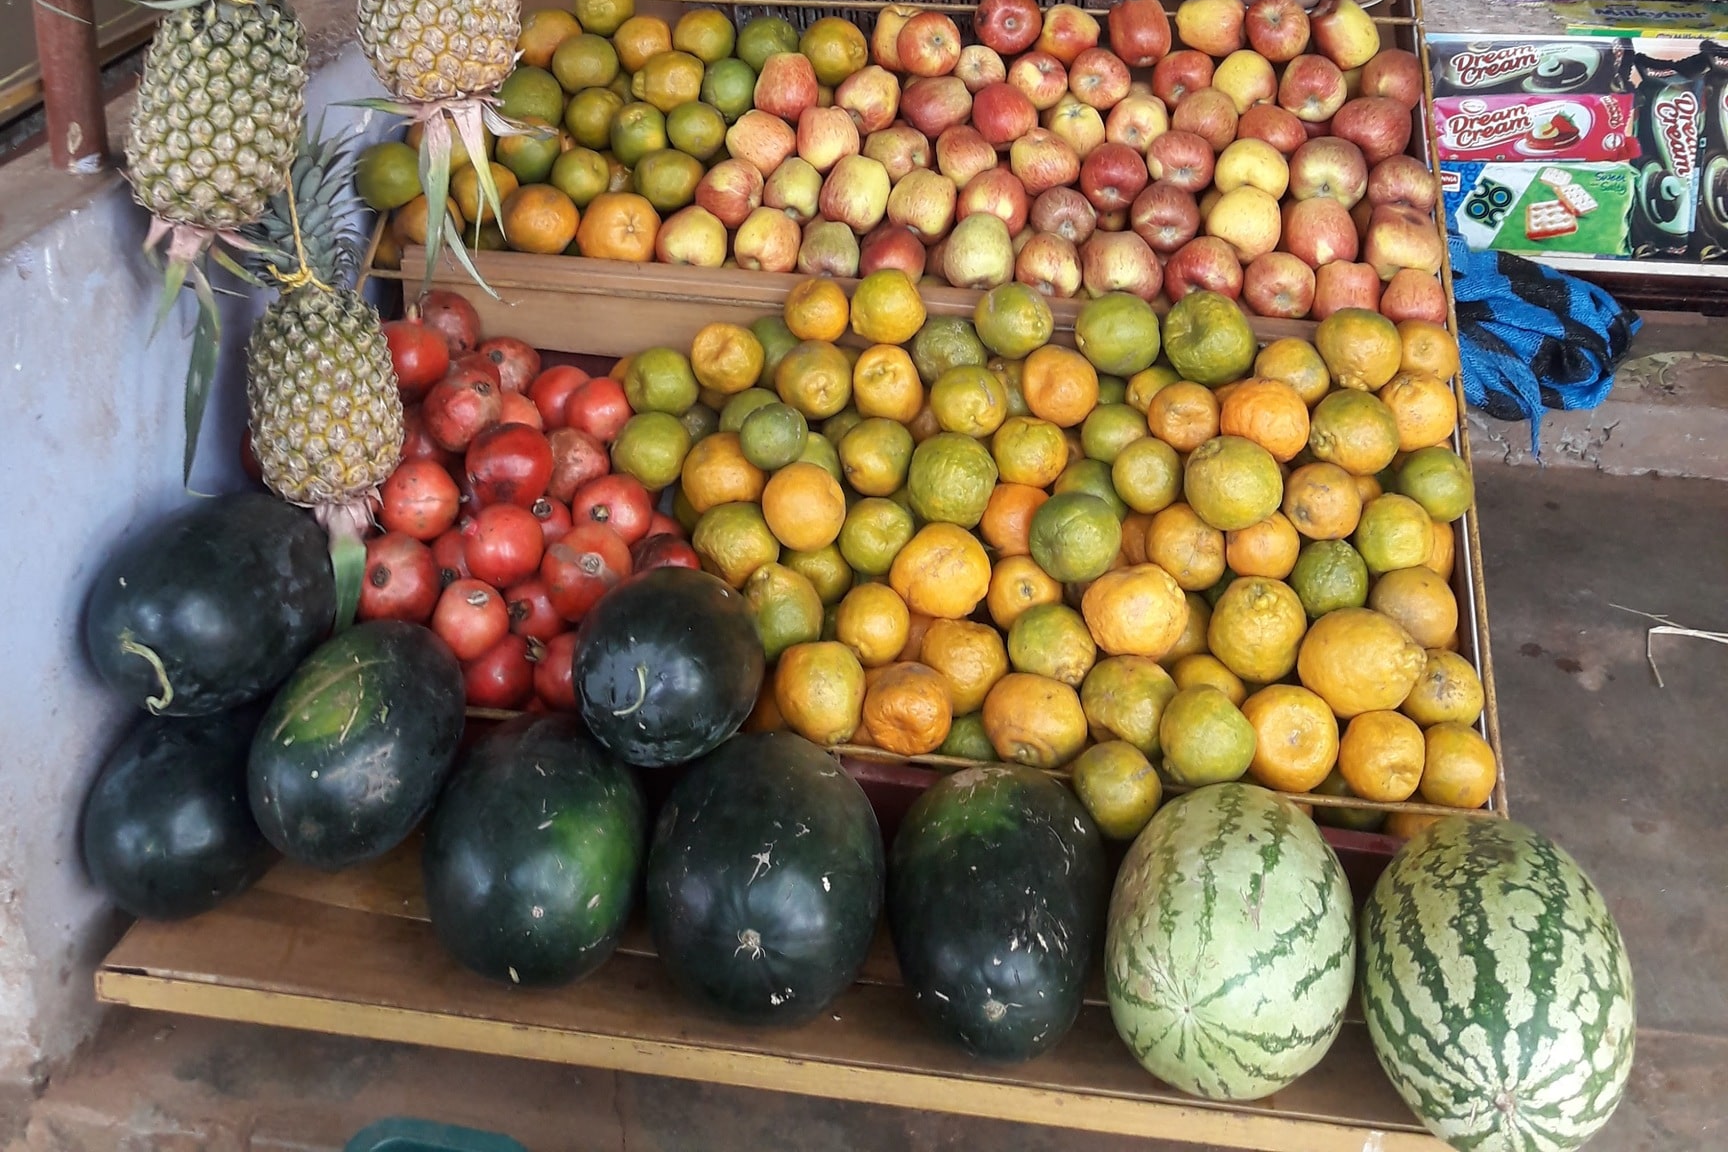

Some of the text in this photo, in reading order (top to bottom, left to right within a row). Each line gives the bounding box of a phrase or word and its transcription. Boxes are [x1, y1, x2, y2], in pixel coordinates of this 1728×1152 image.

[1450, 45, 1533, 72] Dream
[1460, 53, 1538, 85] Cream
[1449, 105, 1527, 133] Dream
[1455, 115, 1531, 147] Cream
[1656, 102, 1691, 175] Cream
